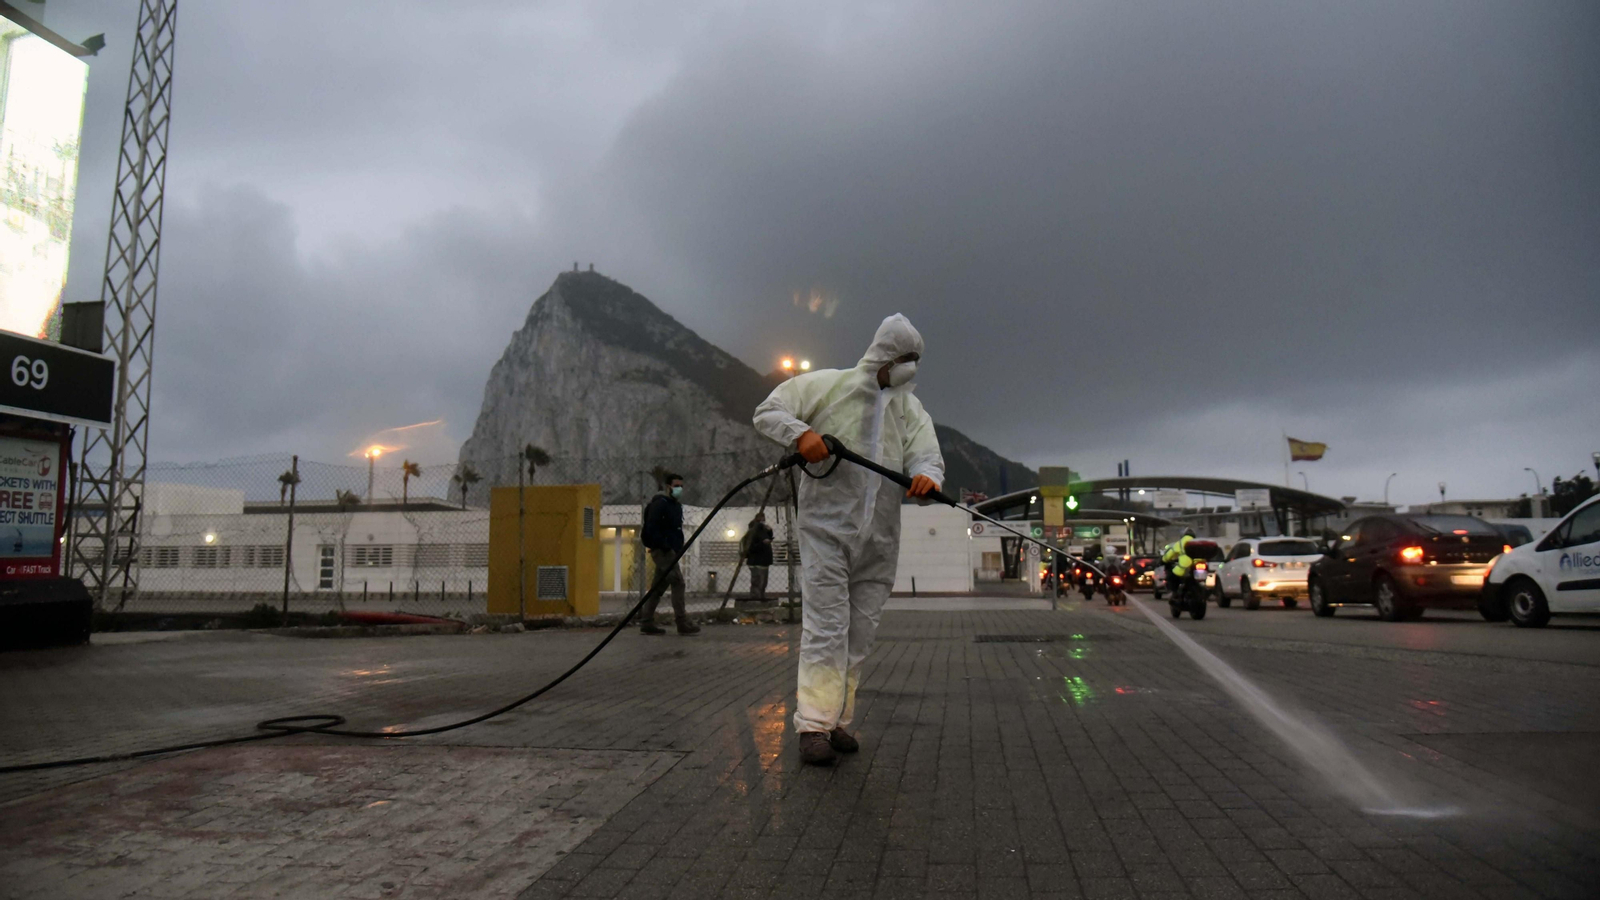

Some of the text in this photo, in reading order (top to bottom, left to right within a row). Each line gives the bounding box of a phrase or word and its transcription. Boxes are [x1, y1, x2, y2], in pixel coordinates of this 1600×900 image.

[11, 355, 49, 390] 69
[32, 479, 56, 491] WITH
[18, 511, 54, 525] SHUTTLE
[6, 565, 52, 575] Car FAST Track
